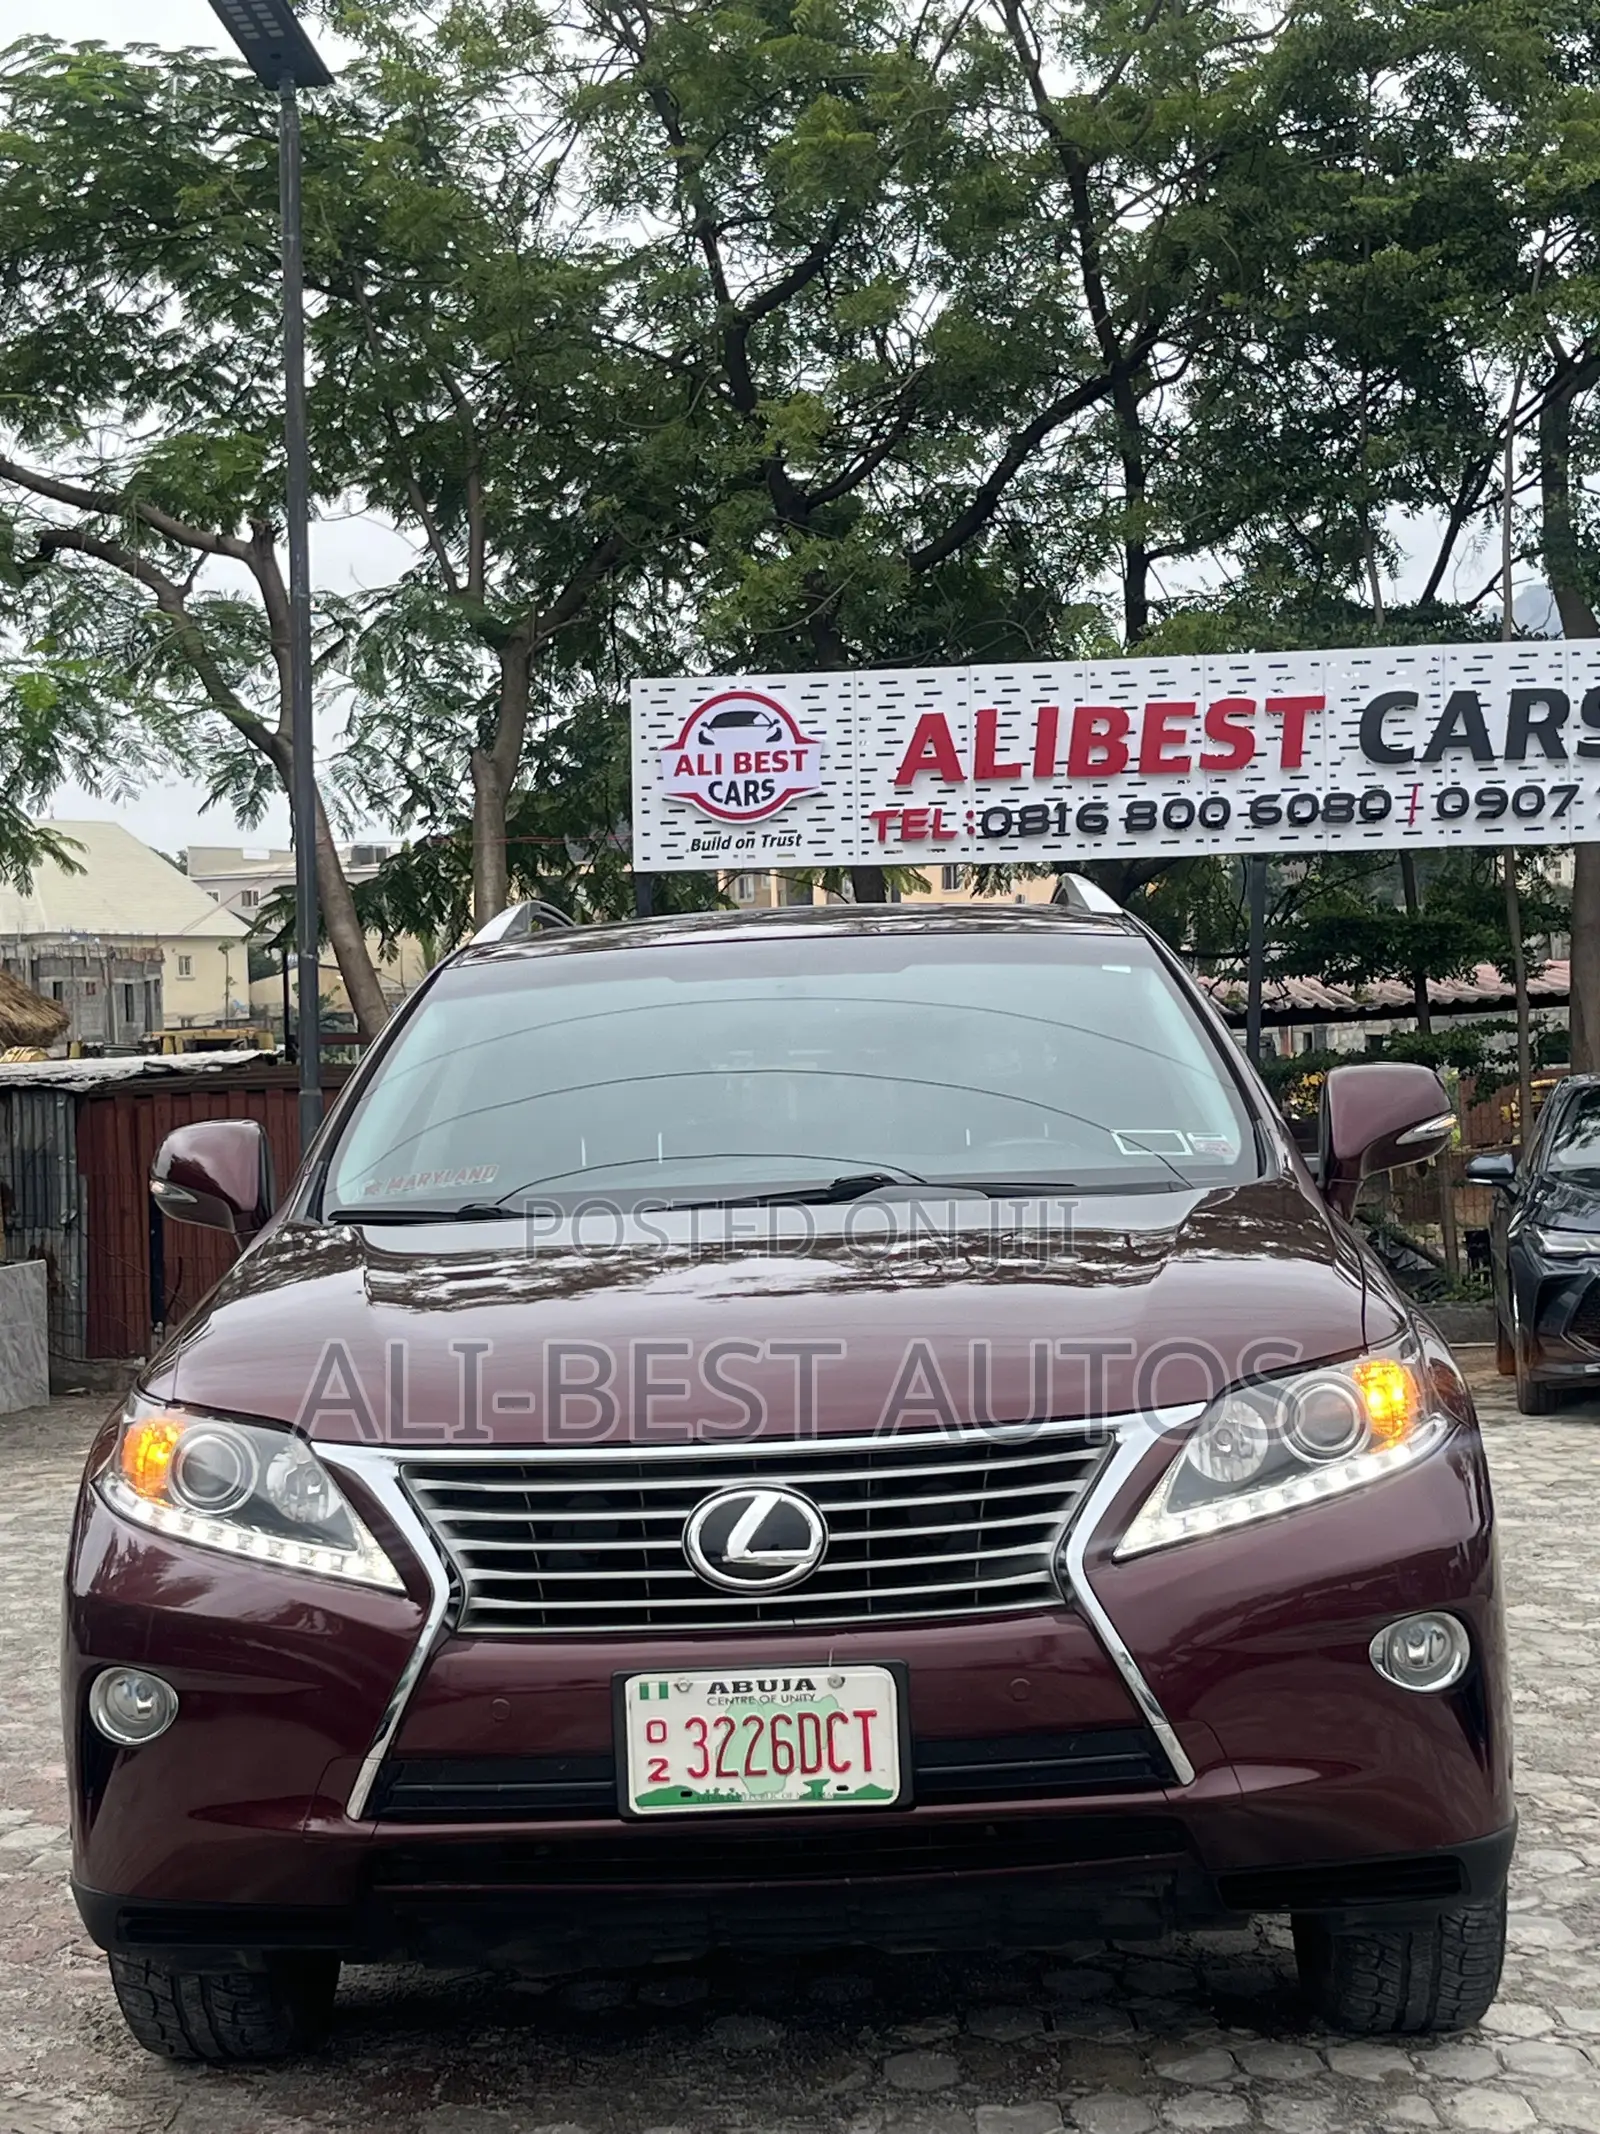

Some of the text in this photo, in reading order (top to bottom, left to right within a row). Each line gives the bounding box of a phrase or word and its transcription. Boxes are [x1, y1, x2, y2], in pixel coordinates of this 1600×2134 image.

[894, 696, 1326, 786] ALIBEST
[673, 749, 809, 777] ALI BEST
[708, 778, 776, 806] CARS
[1124, 796, 1231, 832] 800
[1248, 789, 1393, 826] 6080
[1436, 784, 1581, 820] 0907
[690, 833, 803, 853] Build on Trust
[386, 1164, 500, 1195] MARYLAND
[707, 1678, 817, 1695] ABUJA
[707, 1693, 816, 1707] CENTRE OF UNITY
[684, 1709, 878, 1779] 3226DCT
